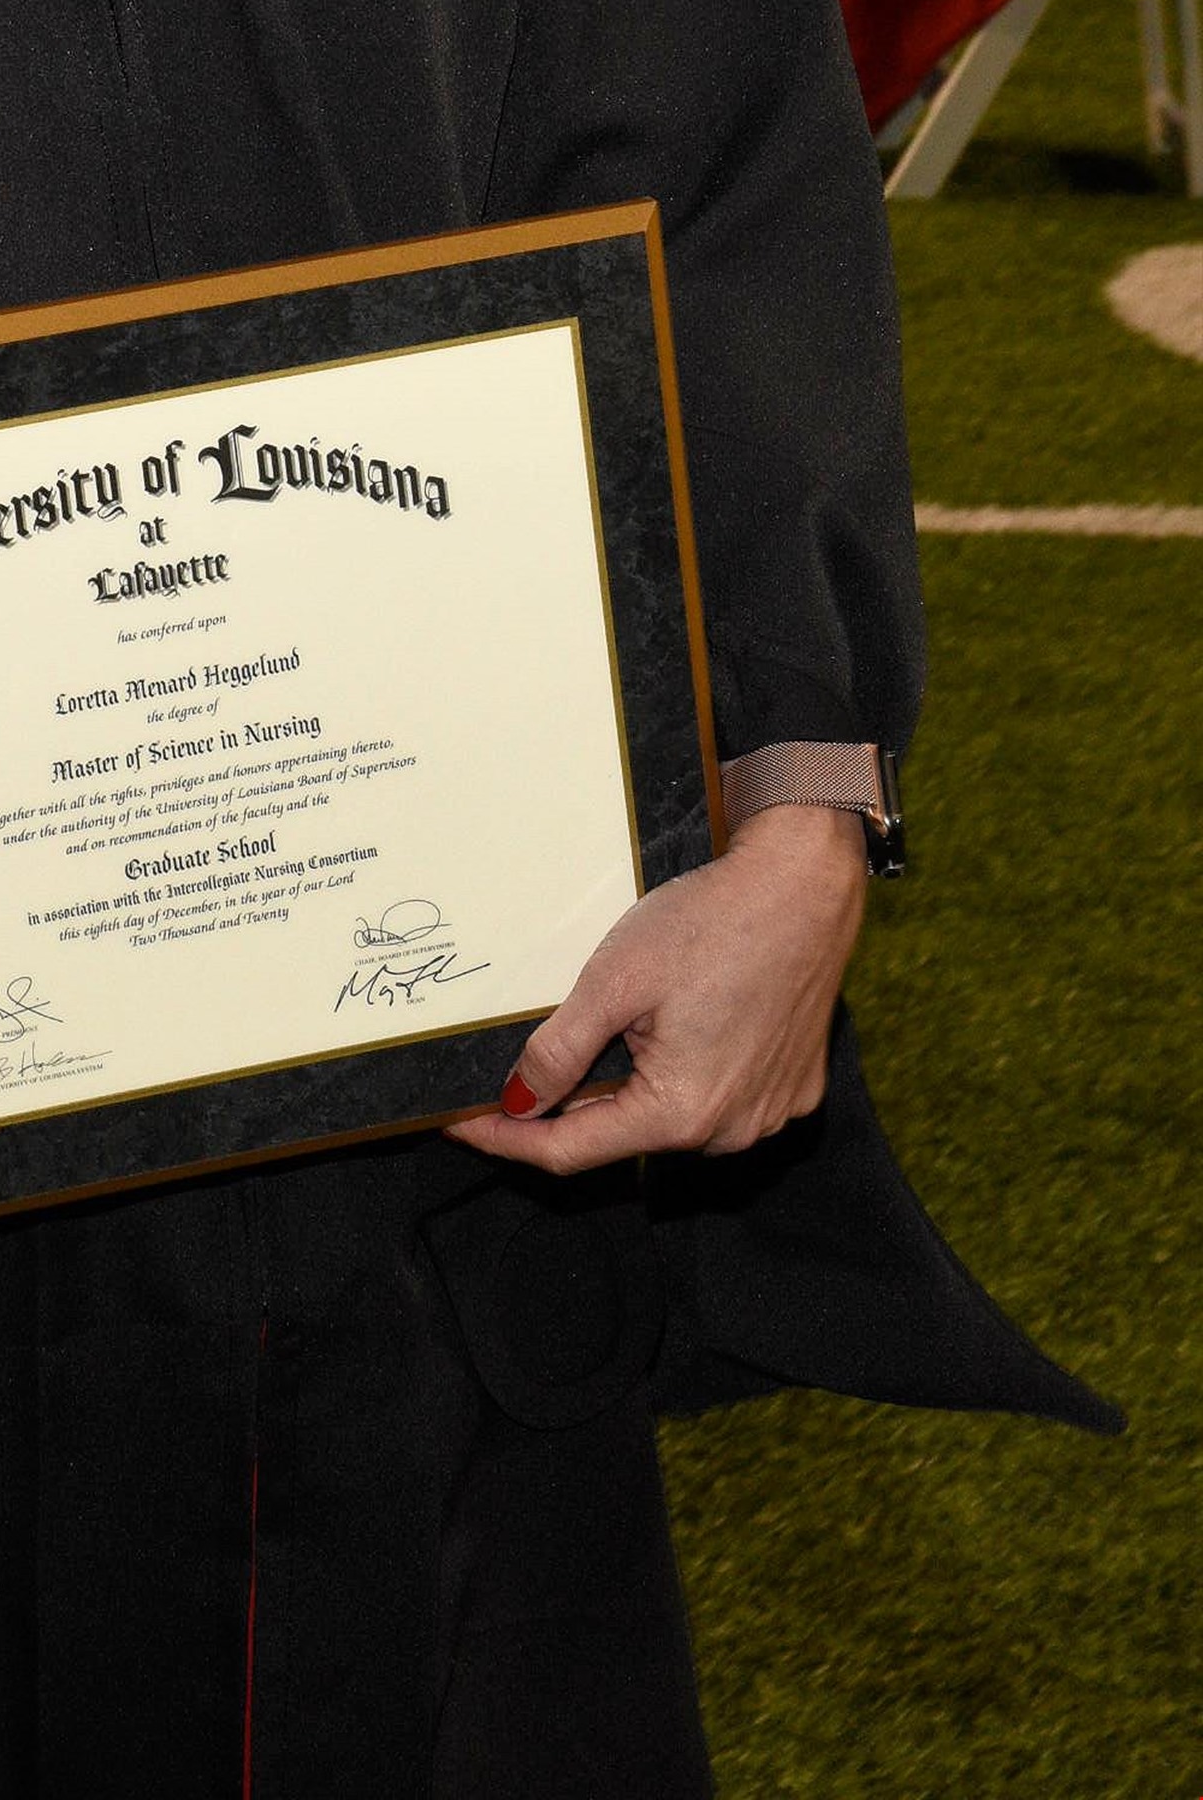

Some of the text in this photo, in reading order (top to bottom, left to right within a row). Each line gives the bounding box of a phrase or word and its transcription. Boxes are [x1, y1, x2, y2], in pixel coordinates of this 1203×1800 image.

[142, 440, 184, 498] of
[199, 425, 451, 521] Louisiana
[140, 517, 169, 547] at
[89, 553, 231, 604] Lafayette
[118, 616, 226, 644] has conferred upon
[56, 647, 300, 715] Loretta Menard Heggelund
[147, 698, 219, 724] the degree of
[39, 799, 67, 816] with
[70, 795, 86, 809] all
[89, 792, 106, 806] the
[111, 786, 146, 806] rights,
[151, 776, 204, 799] privileges
[208, 767, 229, 782] and
[233, 763, 271, 777] honors
[275, 748, 347, 773] appertaining
[352, 740, 393, 754] thereto,
[52, 716, 321, 783] Master of Science in Nursing
[3, 829, 36, 845] under
[40, 824, 57, 838] the
[61, 814, 115, 834] authority
[119, 808, 132, 827] of
[135, 805, 152, 819] the
[156, 794, 218, 814] University
[221, 787, 235, 806] of
[237, 780, 294, 799] Louisiana
[297, 769, 333, 787] Board
[336, 765, 349, 784] of
[351, 756, 416, 779] Supervisors
[66, 792, 329, 855] and on recommendation of the faculty and the
[28, 847, 378, 926] in association with the Intercollegiate Nursing Consortium
[125, 830, 276, 880] Graduate School
[60, 870, 355, 941] this eighth day of December, in the year of our Lord
[129, 908, 289, 947] Two Thousand and Twenty
